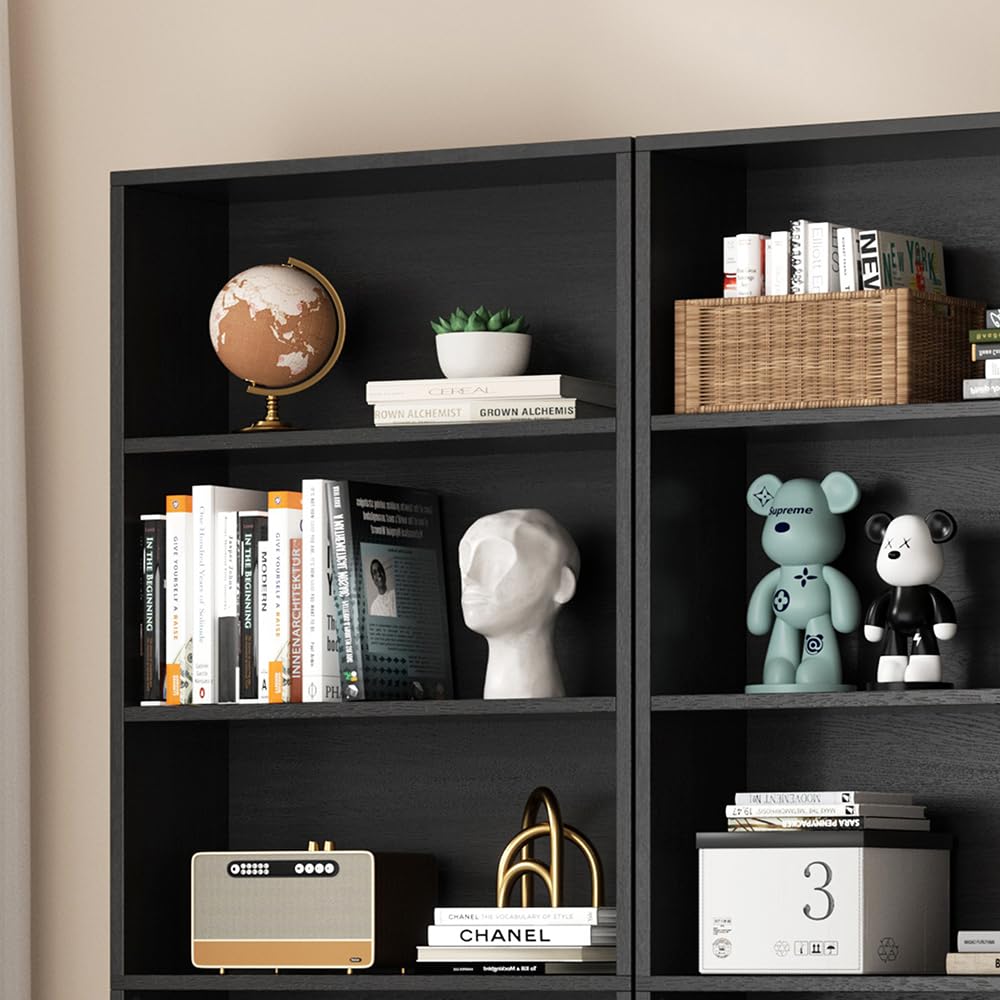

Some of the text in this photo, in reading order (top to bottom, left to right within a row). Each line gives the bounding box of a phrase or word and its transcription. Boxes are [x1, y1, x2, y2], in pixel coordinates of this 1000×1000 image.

[407, 408, 462, 419] ALCHEMIST
[479, 407, 518, 417] GROWN
[769, 506, 813, 517] Supreme
[146, 537, 154, 632] IN THE BEGINNING
[244, 534, 252, 629] IN THE BEGINNING
[291, 548, 300, 679] INNENARCHITEKTUR
[839, 818, 860, 827] SARA
[803, 861, 835, 921] 3
[460, 929, 551, 942] CHANEL
